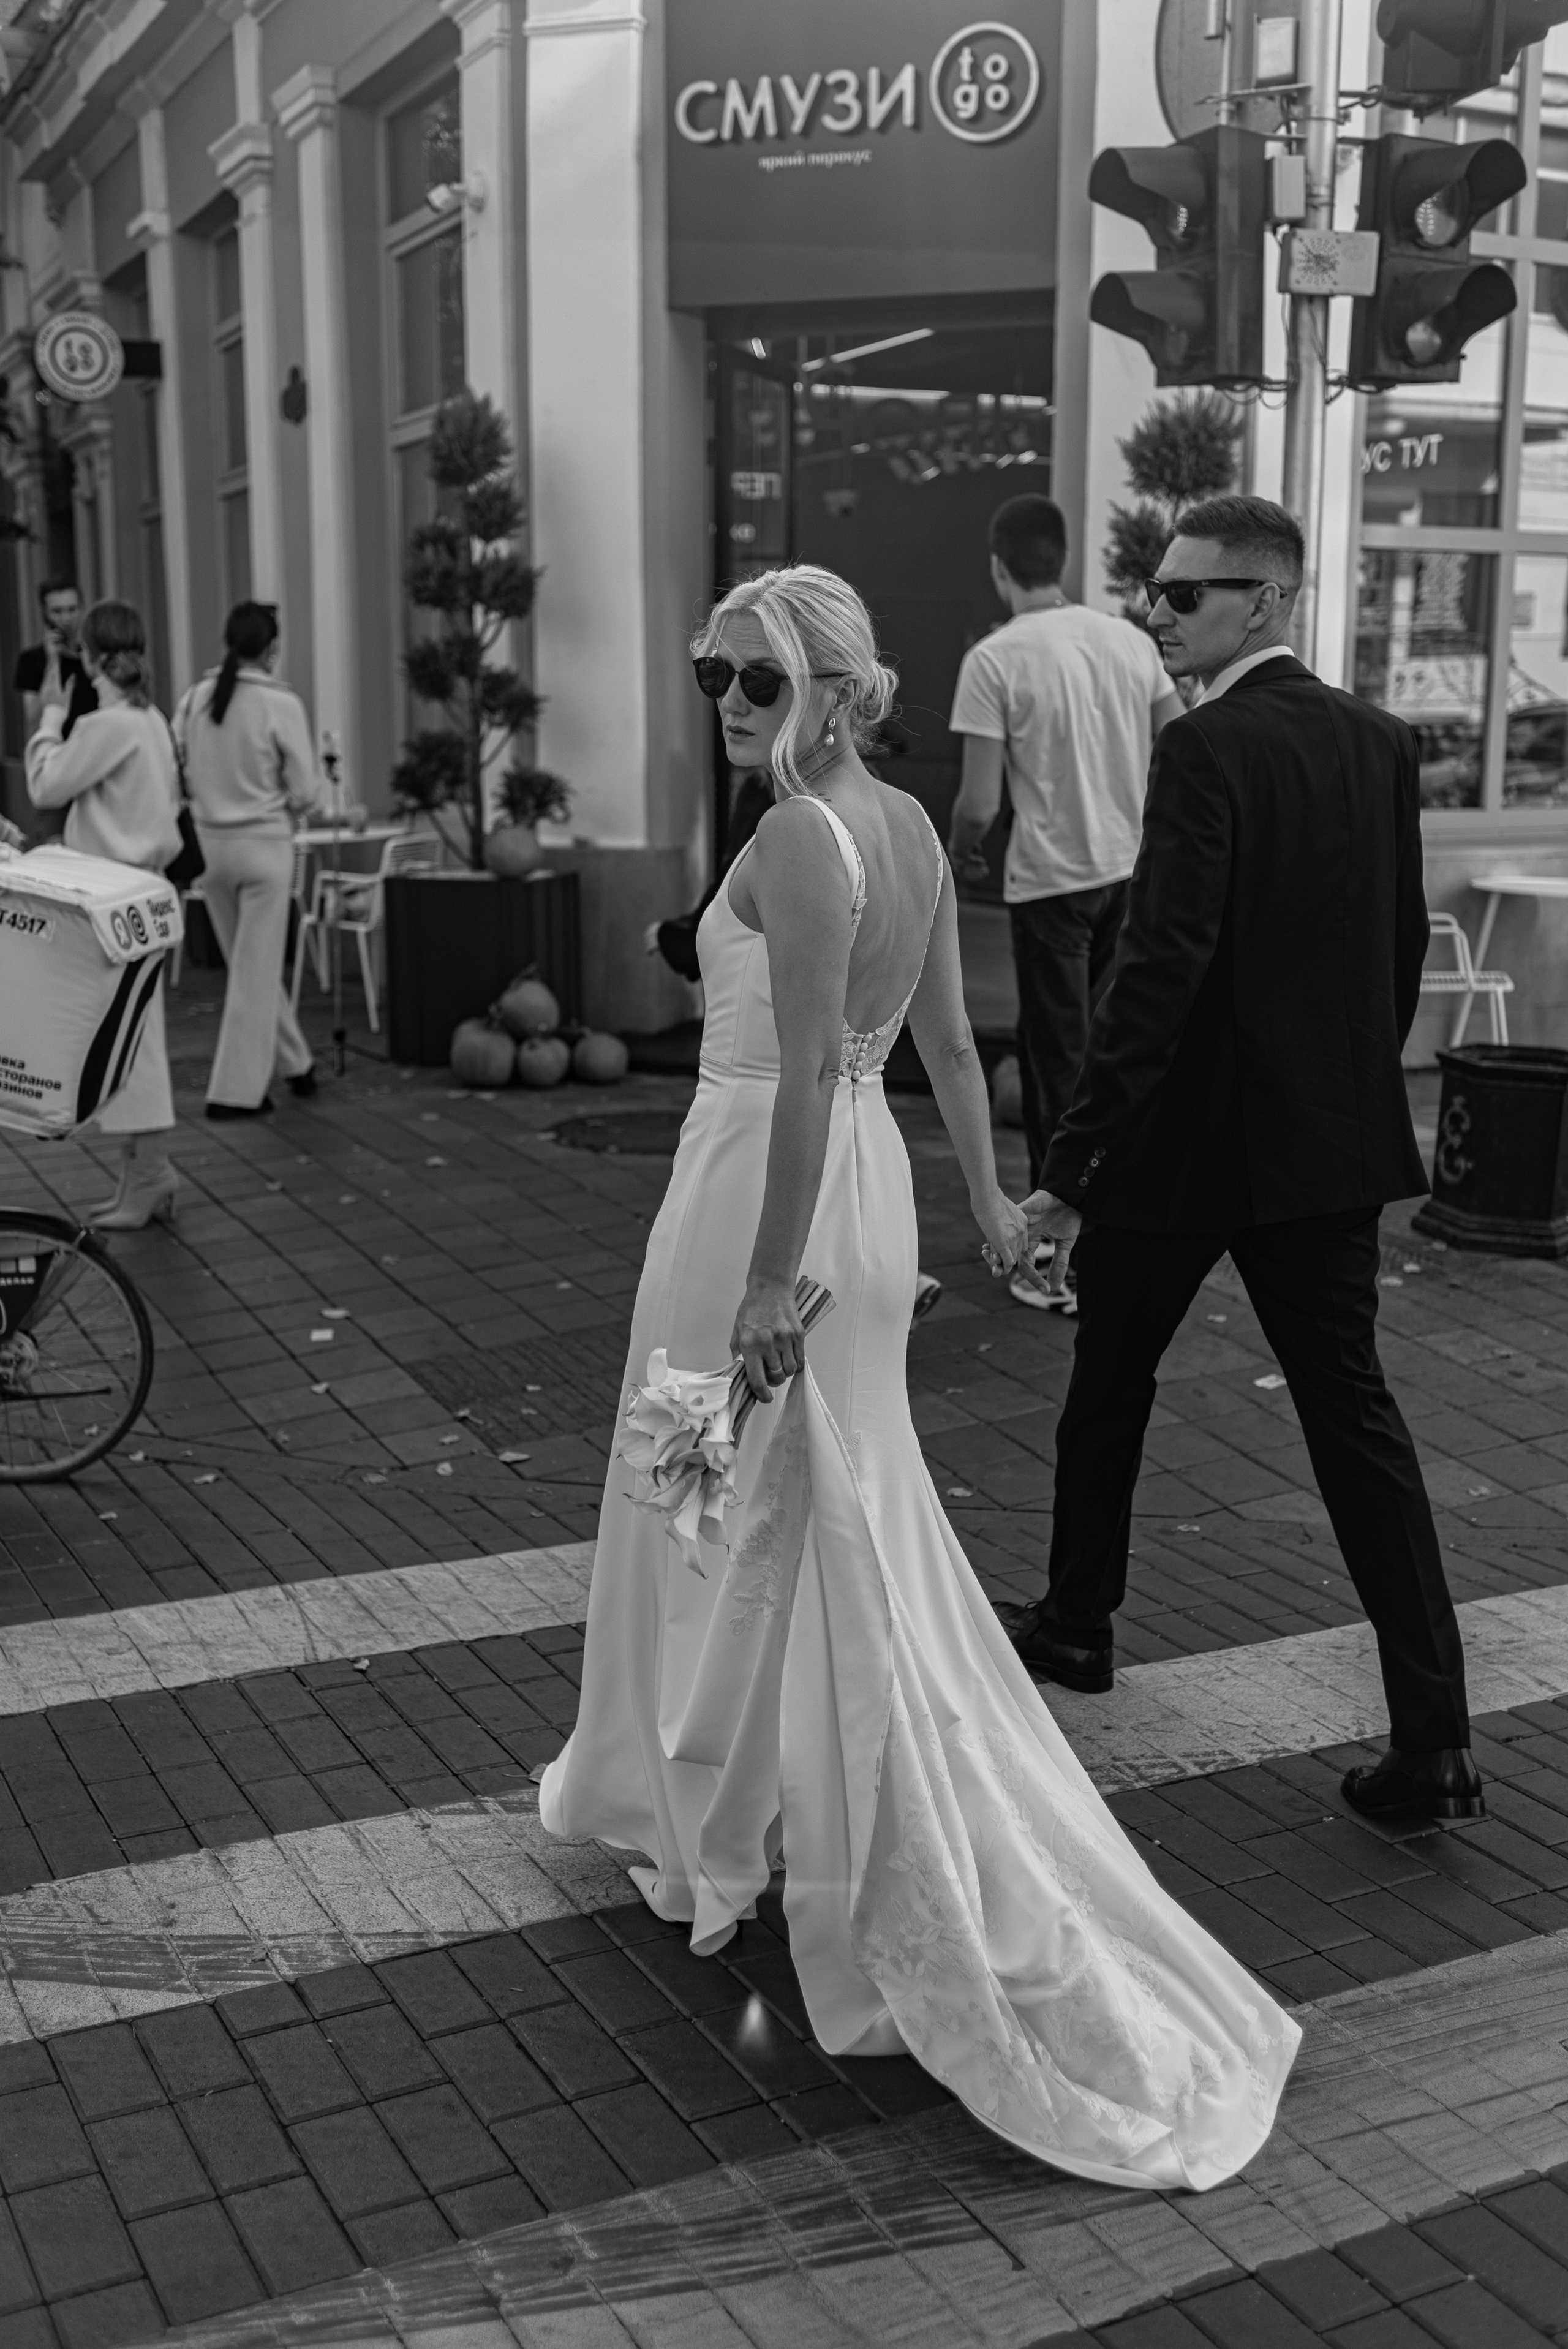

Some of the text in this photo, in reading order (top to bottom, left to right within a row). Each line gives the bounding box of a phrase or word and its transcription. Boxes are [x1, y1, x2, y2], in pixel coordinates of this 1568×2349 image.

[958, 45, 1009, 81] to
[675, 63, 916, 143] СМУЗИ
[953, 83, 1011, 119] go
[1398, 433, 1444, 469] ТУТ
[0, 1056, 25, 1071] вка
[0, 1081, 42, 1100] зинов
